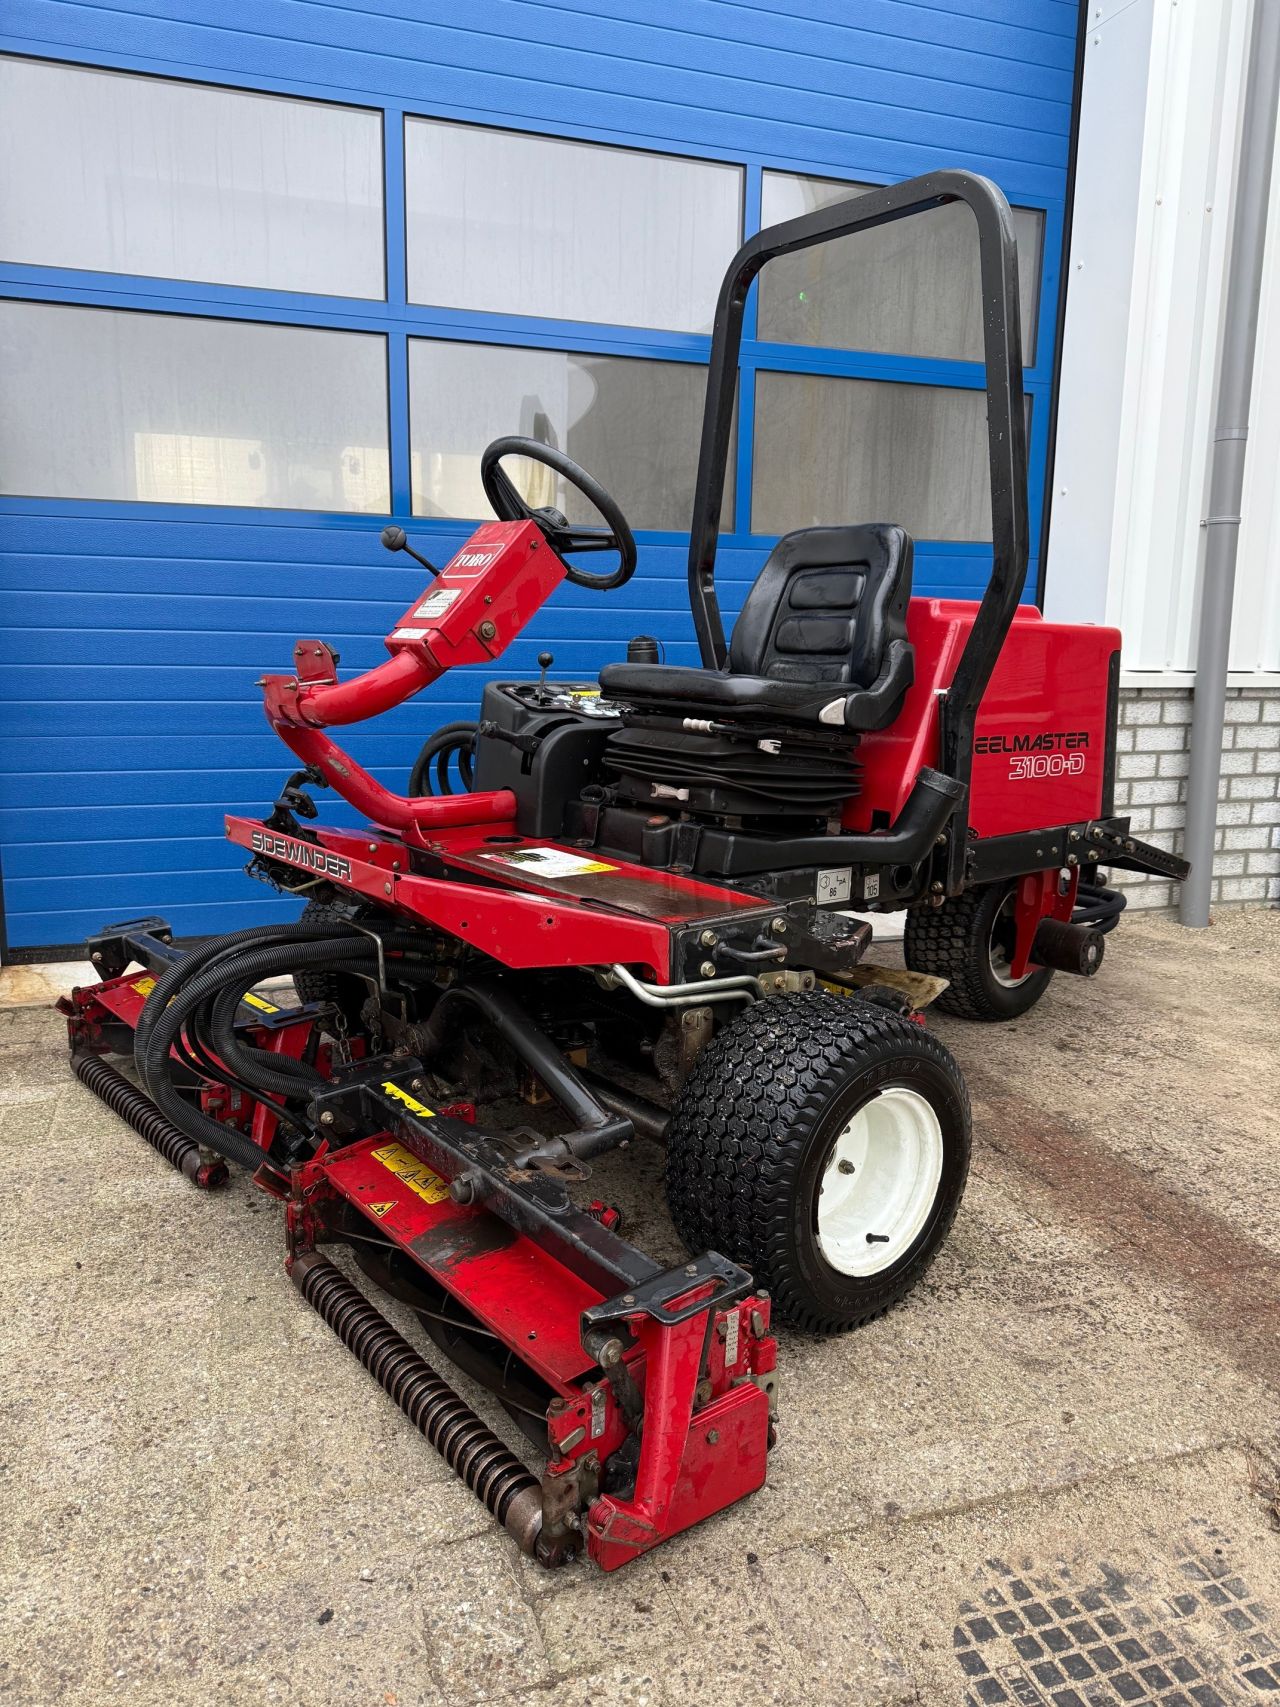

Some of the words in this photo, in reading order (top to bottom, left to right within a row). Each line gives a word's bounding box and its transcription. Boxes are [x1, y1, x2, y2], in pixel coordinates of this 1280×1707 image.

[454, 553, 493, 567] TORO
[974, 732, 1089, 754] EELMASTER
[252, 830, 352, 882] SIDEWINDER
[829, 887, 837, 897] 86
[866, 883, 878, 897] 105
